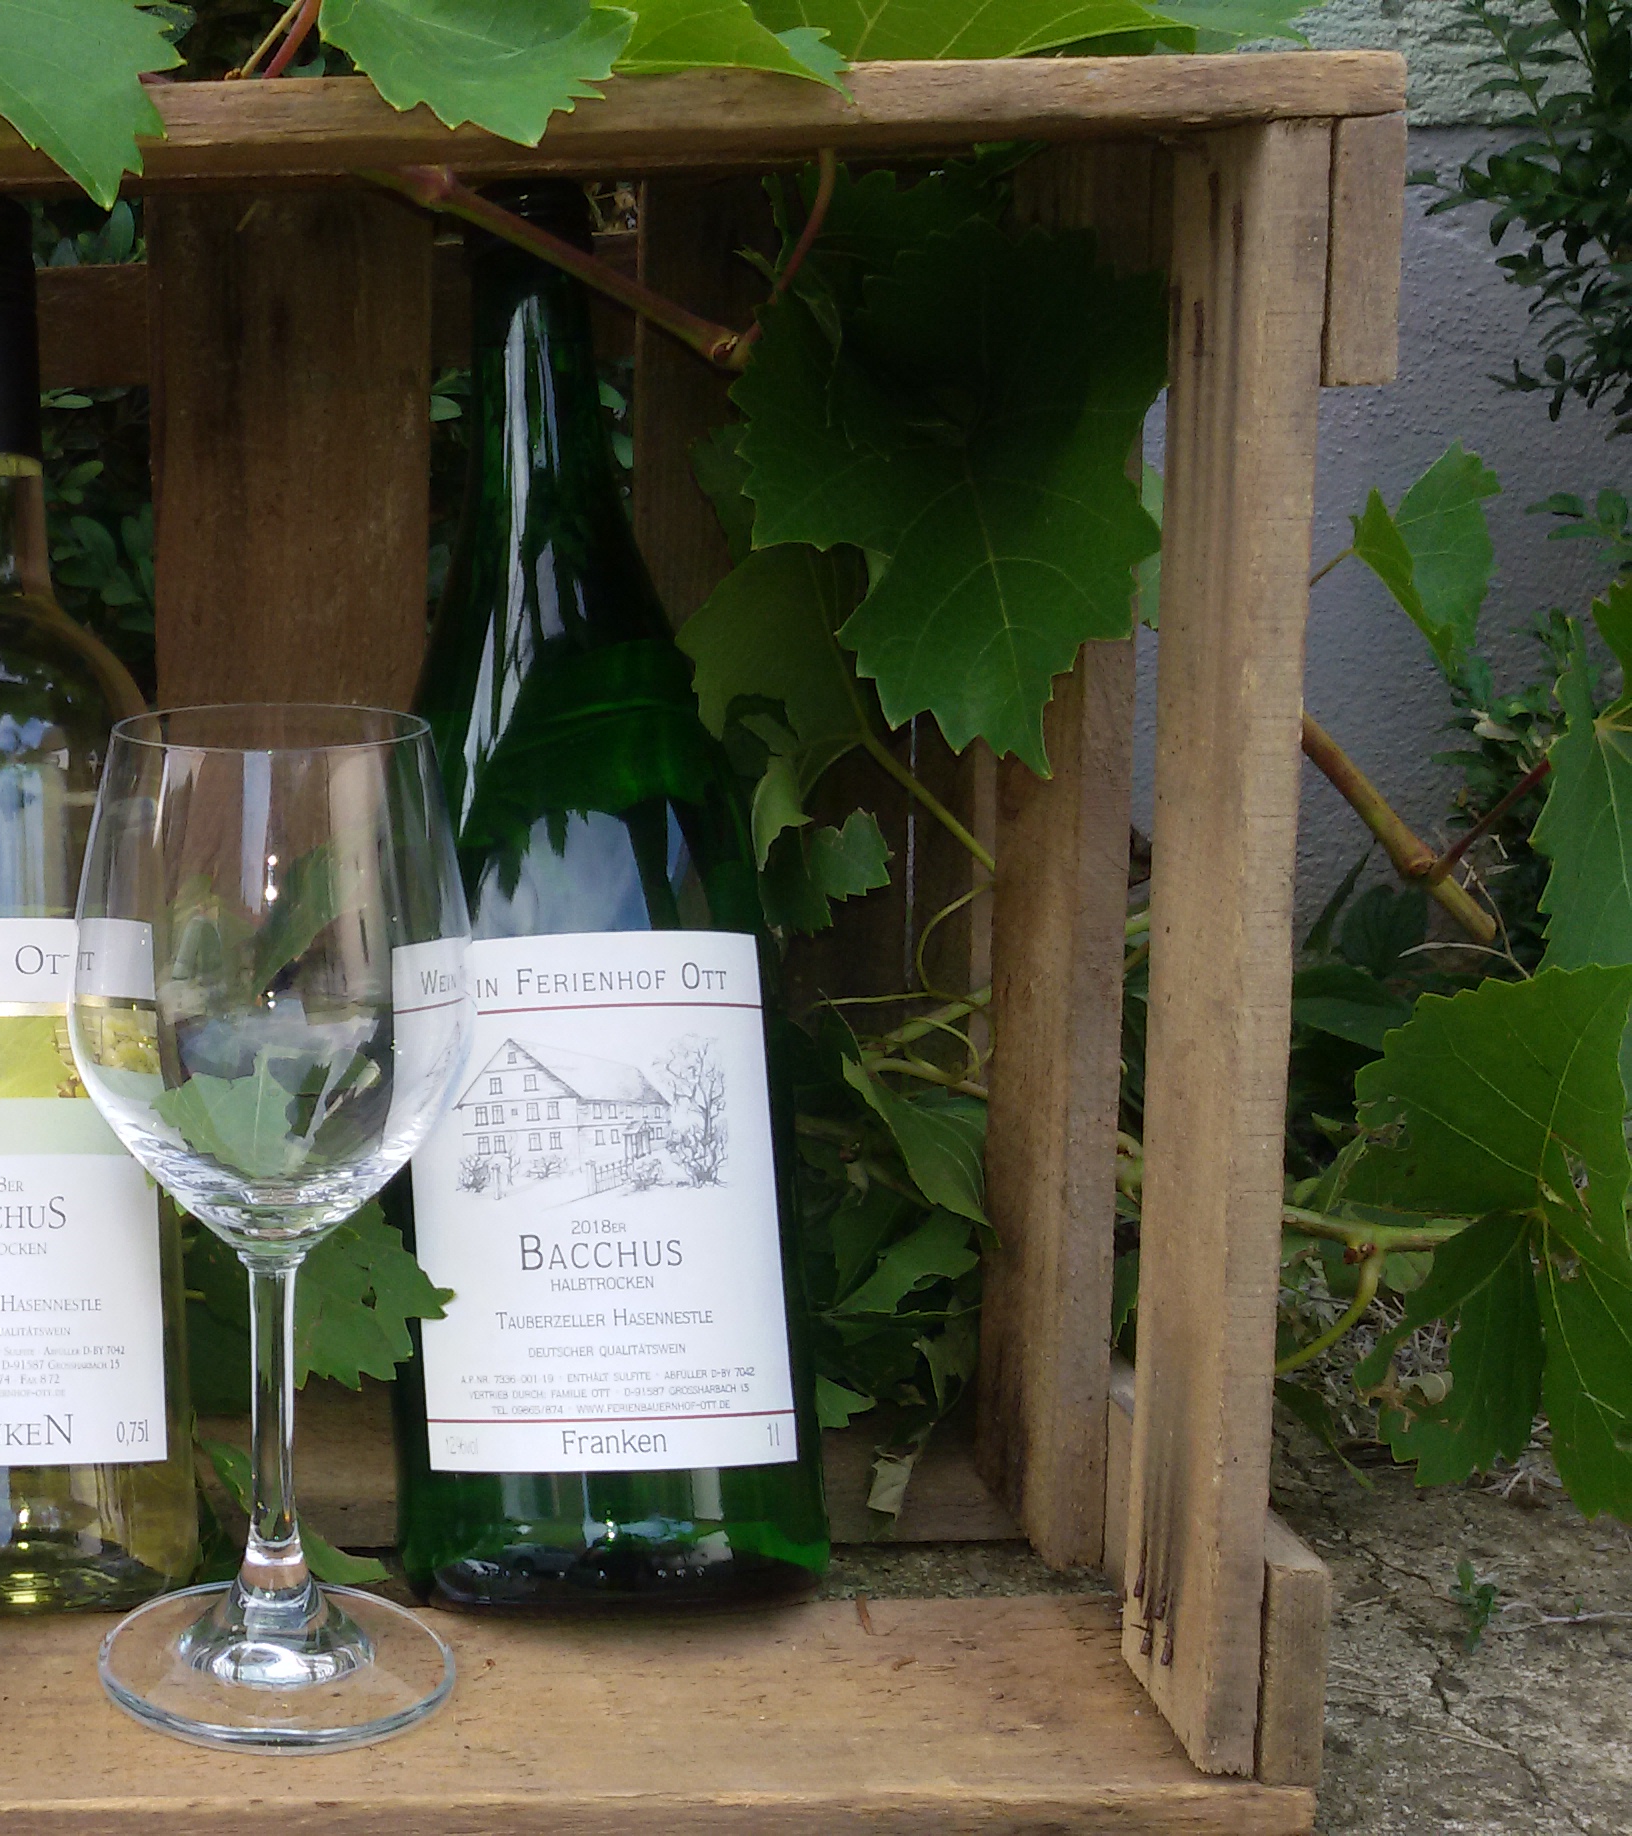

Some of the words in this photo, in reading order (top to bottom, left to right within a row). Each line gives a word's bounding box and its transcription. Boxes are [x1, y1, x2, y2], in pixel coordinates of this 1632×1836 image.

[516, 967, 666, 995] FERIENHOF
[680, 962, 728, 991] OTT
[571, 1219, 627, 1235] 2018ER
[519, 1234, 684, 1271] BACCHUS
[550, 1275, 655, 1292] HALBTROCKEN
[0, 1295, 102, 1312] HASENNESTLE
[495, 1311, 606, 1330] TAUBERZELLER
[612, 1307, 714, 1327] HASENNESTLE
[528, 1344, 594, 1358] DEUTSCHER
[599, 1341, 686, 1357] QUALITÄTSWEIN
[591, 1388, 611, 1398] OTT
[561, 1429, 668, 1455] Franken
